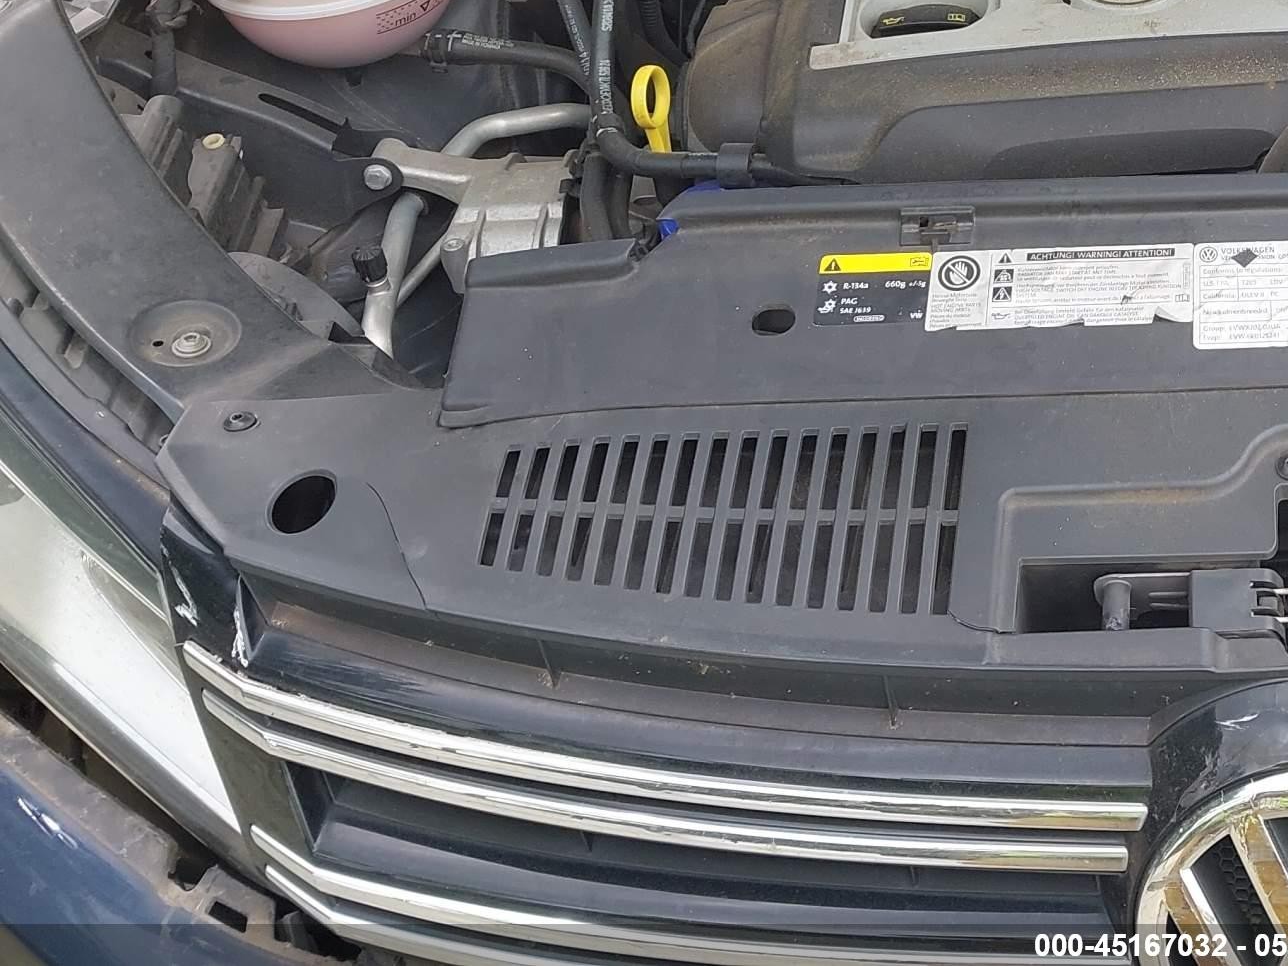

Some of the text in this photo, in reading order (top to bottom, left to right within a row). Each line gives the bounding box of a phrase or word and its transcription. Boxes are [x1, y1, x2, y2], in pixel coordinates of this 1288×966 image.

[395, 12, 417, 26] min
[1030, 247, 1172, 261] ACHTUNG! WARNING! ATTENTION!
[842, 281, 870, 290] R-134a
[884, 280, 906, 290] 660g
[840, 297, 858, 305] PAG
